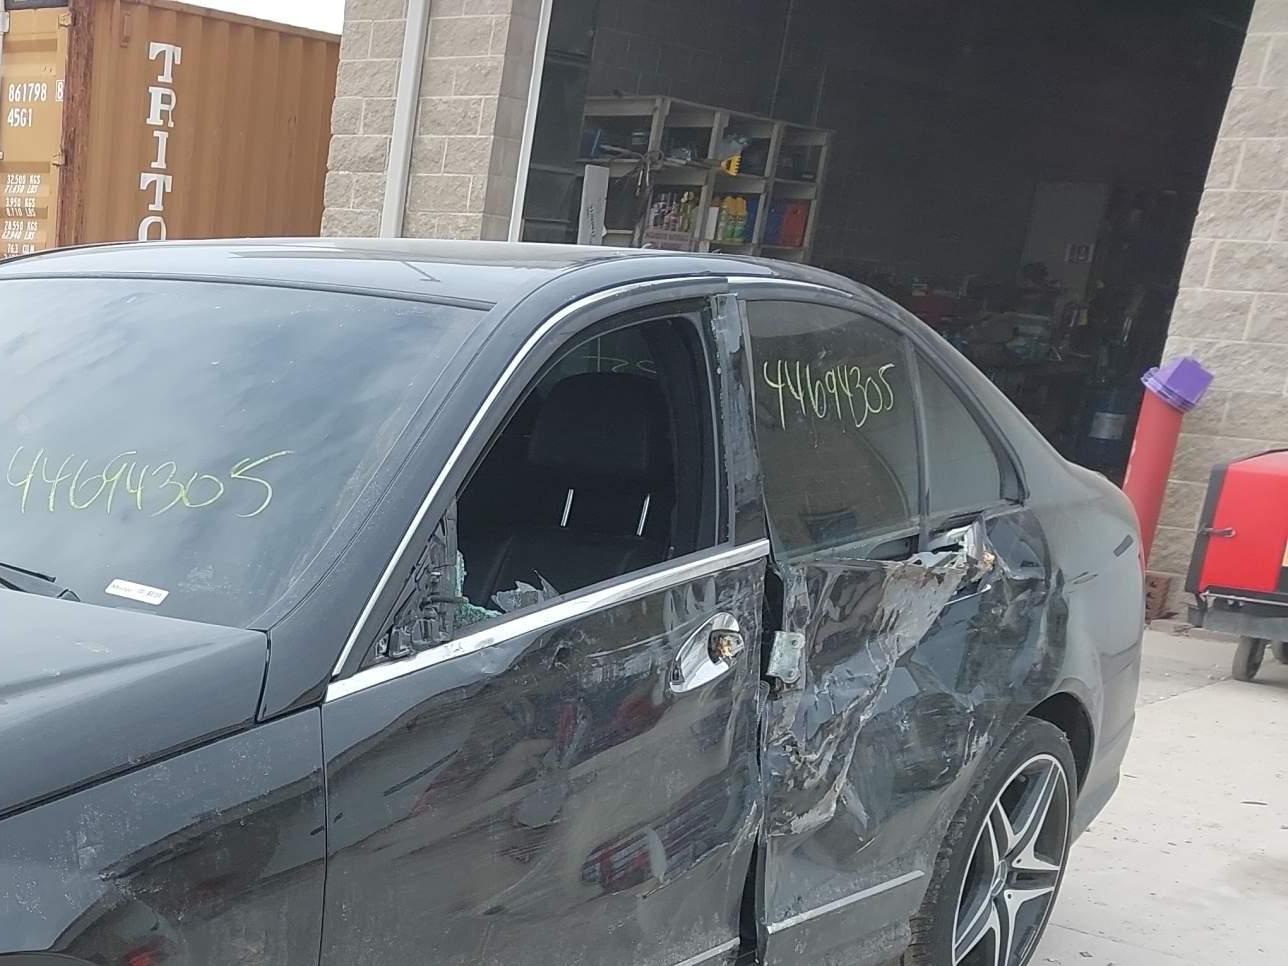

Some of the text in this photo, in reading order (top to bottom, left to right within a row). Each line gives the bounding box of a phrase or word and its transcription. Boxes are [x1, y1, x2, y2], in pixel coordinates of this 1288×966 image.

[8, 83, 47, 102] 861798
[7, 108, 32, 127] 45G1
[29, 175, 40, 184] KGS
[27, 185, 39, 194] LBS
[24, 198, 36, 208] KGS
[27, 221, 38, 231] KGS
[763, 359, 896, 432] 44694305
[6, 446, 295, 518] 44694305
